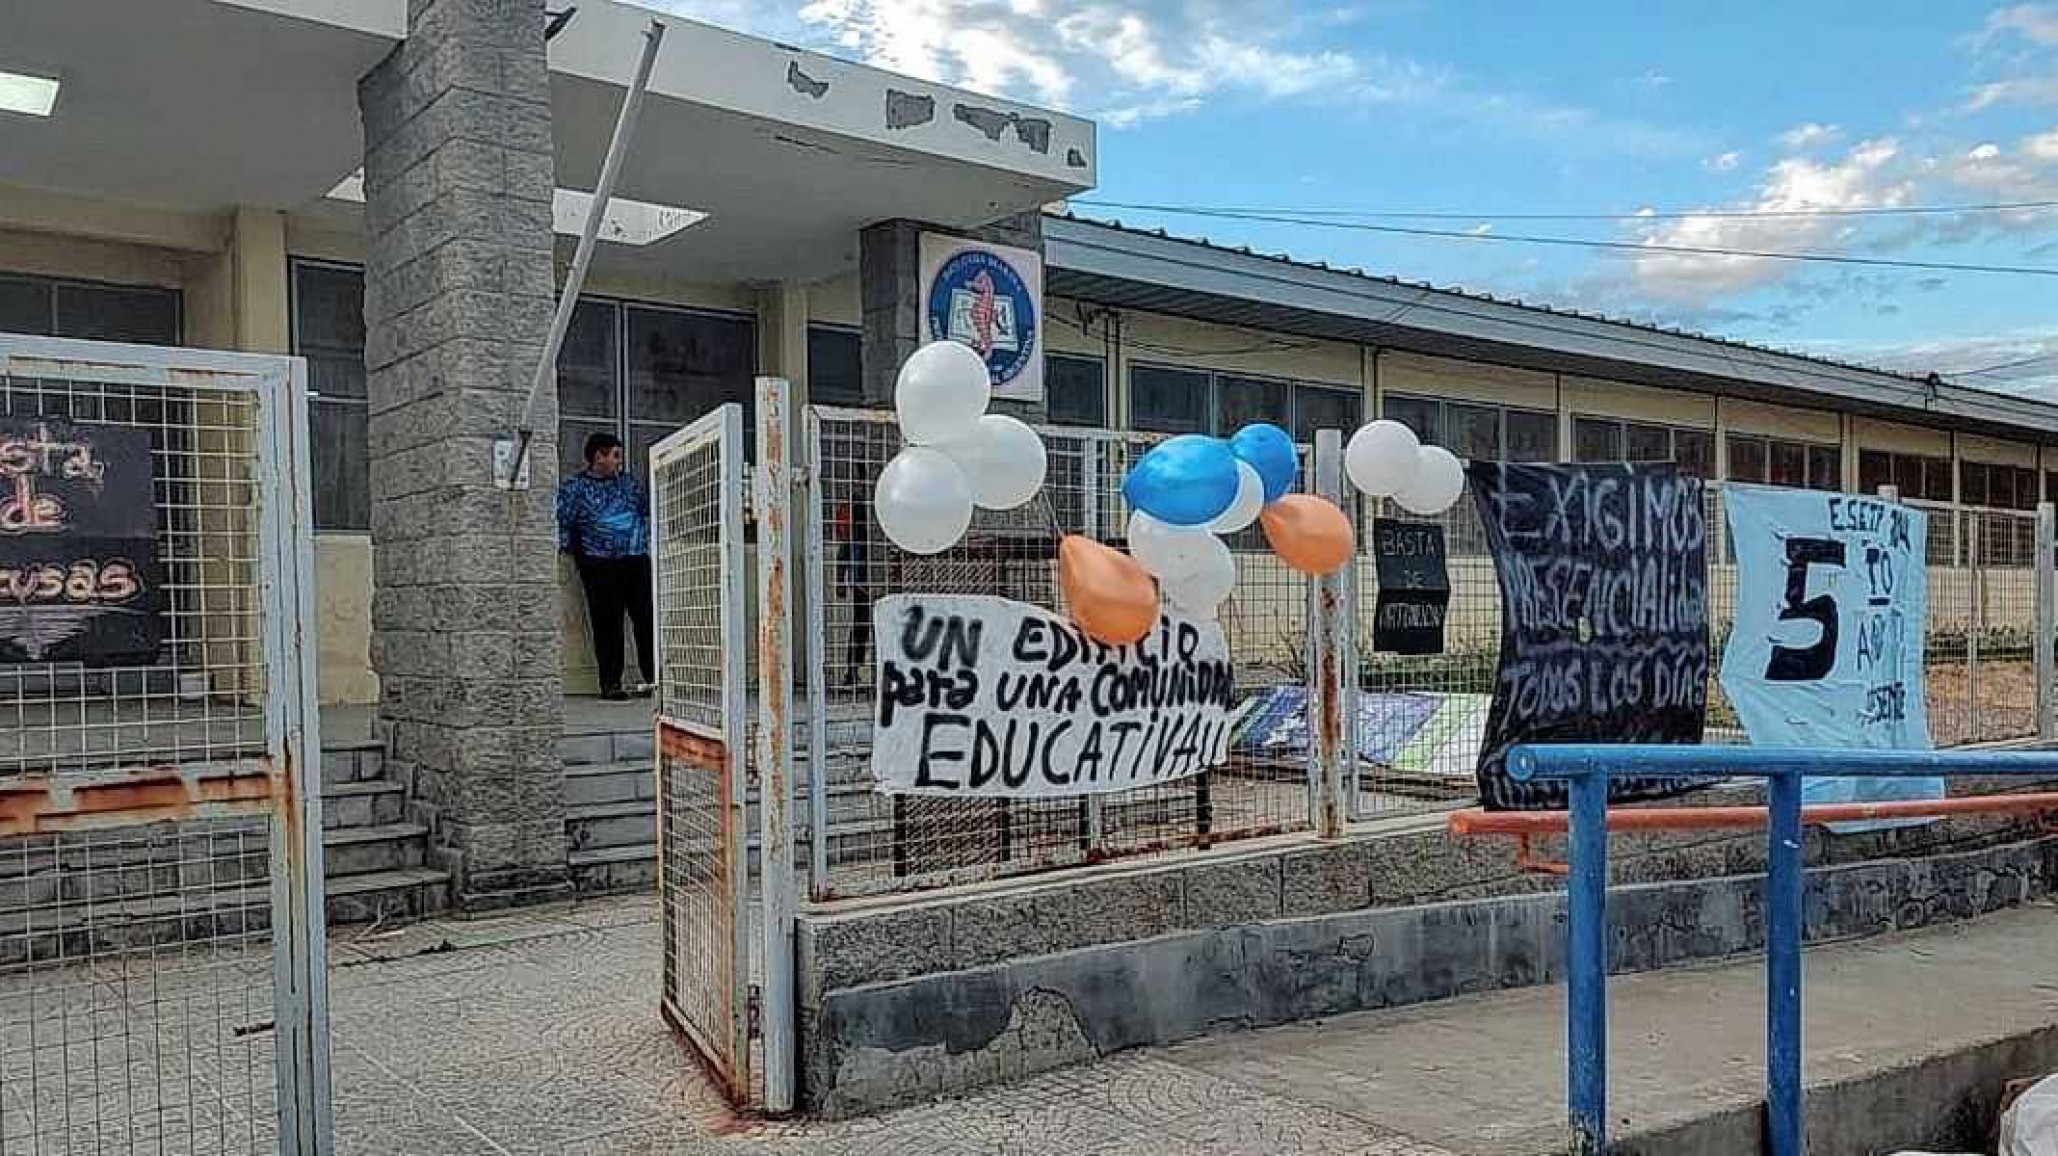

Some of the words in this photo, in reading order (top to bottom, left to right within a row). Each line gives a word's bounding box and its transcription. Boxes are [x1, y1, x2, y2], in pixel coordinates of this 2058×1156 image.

[902, 604, 982, 670] UN
[1765, 537, 1846, 681] 5
[880, 660, 979, 727] para
[997, 672, 1081, 714] UNA
[1590, 660, 1643, 713] LOS
